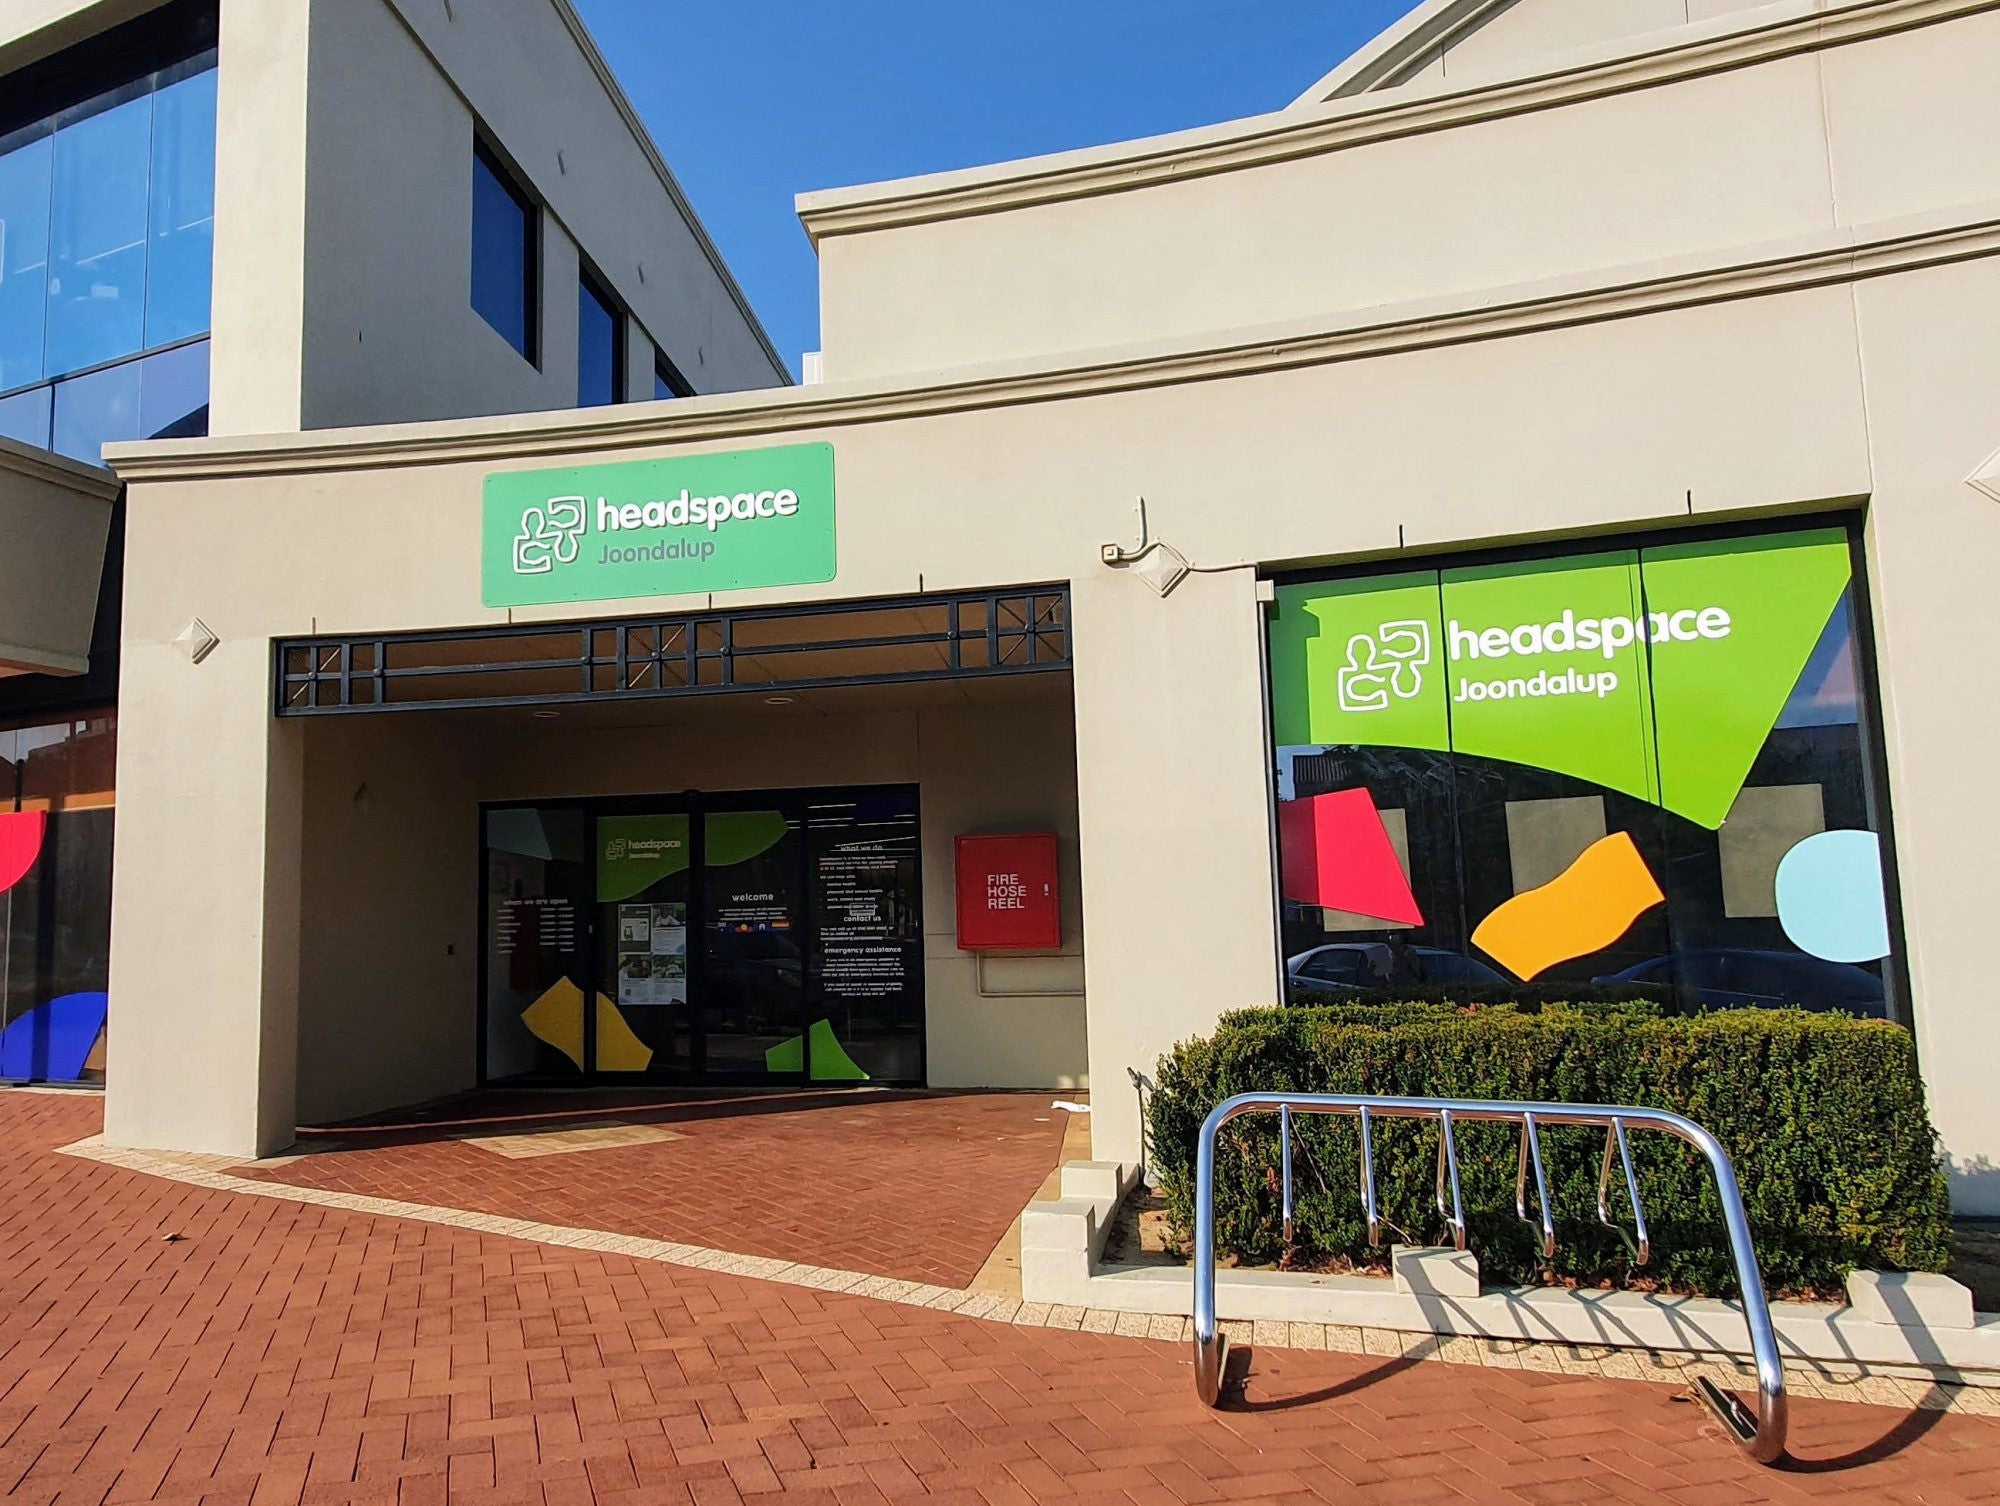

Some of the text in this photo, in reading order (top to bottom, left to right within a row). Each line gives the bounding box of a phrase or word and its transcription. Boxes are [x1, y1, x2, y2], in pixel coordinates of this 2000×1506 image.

[597, 488, 799, 532] headspace
[598, 538, 715, 564] Joondalup
[1449, 606, 1731, 660] headspace
[1454, 667, 1618, 702] Joondalup
[628, 839, 681, 851] headspace
[987, 874, 1019, 885] FIRE
[987, 886, 1027, 897] HOSE
[732, 893, 774, 902] welcome
[988, 898, 1025, 909] REEL
[824, 945, 902, 955] emergency assistance
